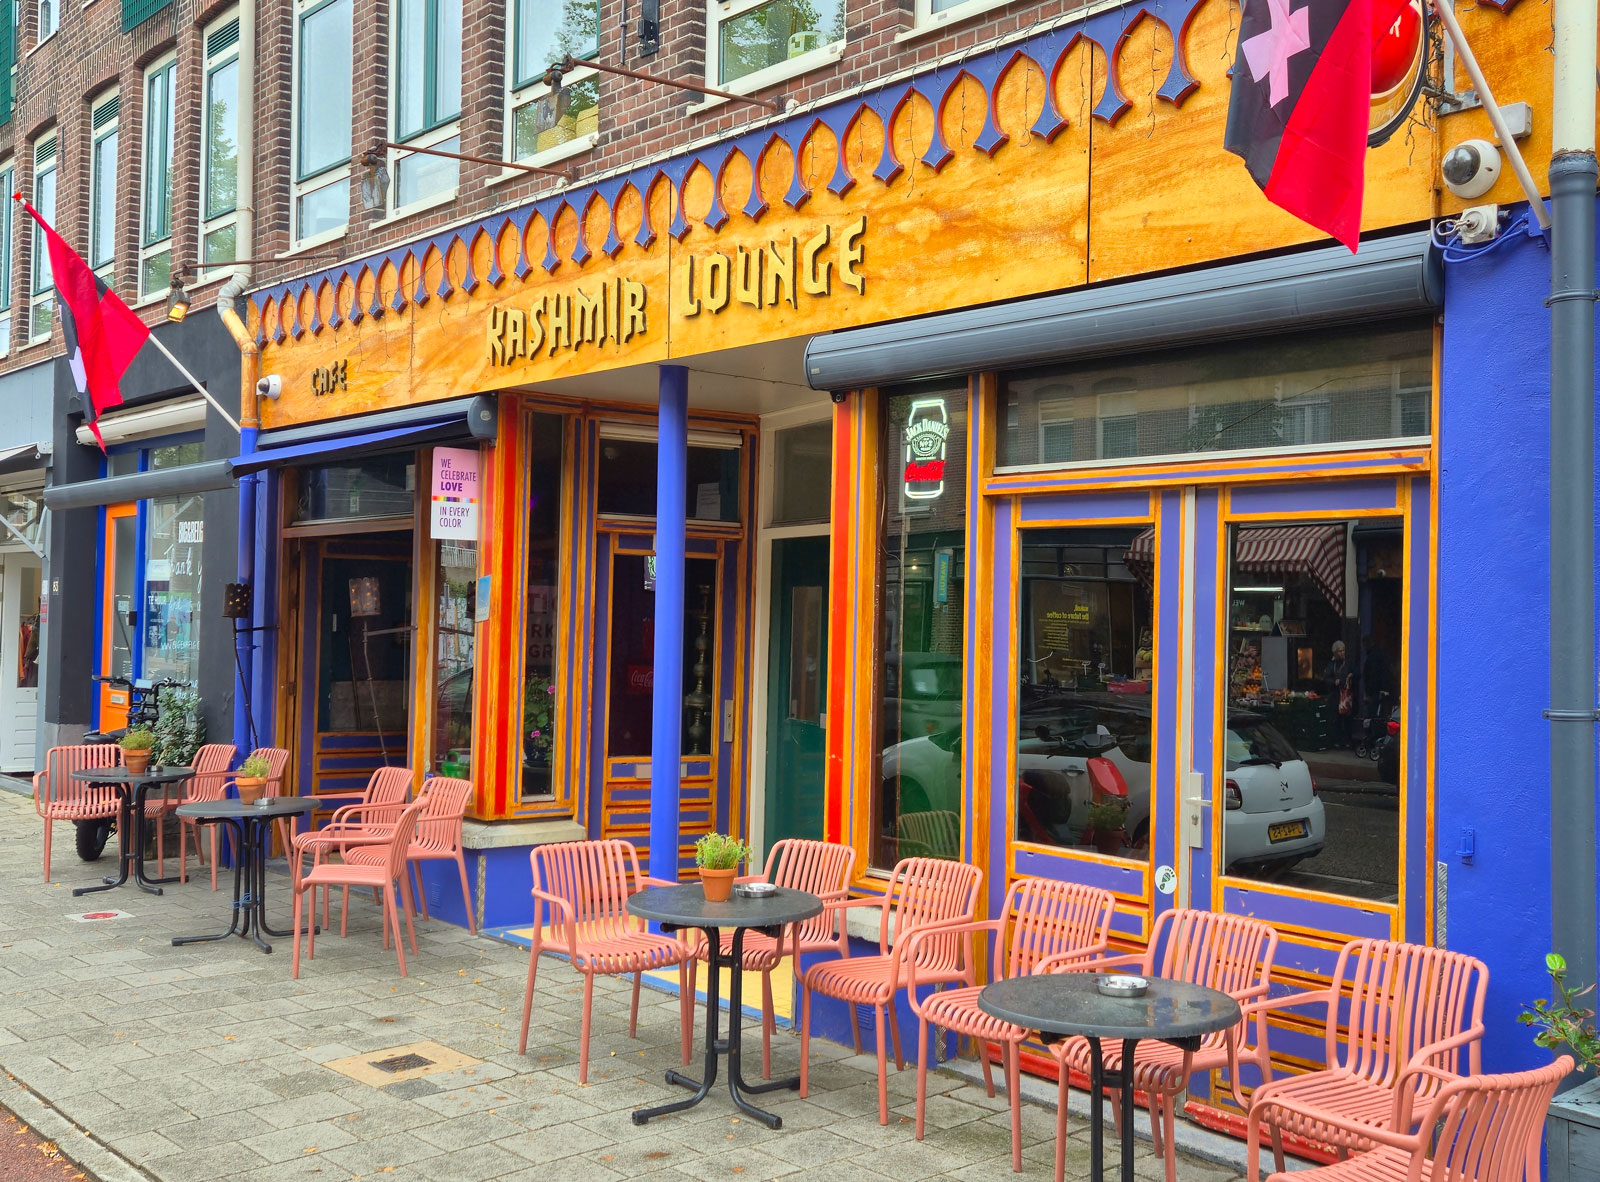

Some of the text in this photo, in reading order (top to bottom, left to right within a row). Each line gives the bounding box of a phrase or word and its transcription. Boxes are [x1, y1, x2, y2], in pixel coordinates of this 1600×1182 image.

[490, 216, 867, 367] KASHMIR LOUNGE
[312, 359, 348, 397] CAFE
[906, 424, 922, 441] JACK
[441, 459, 451, 468] WE
[441, 470, 476, 481] CELEBRATE
[441, 482, 462, 491] LOVE
[439, 506, 469, 517] IN EVERY
[440, 518, 461, 527] COLOR
